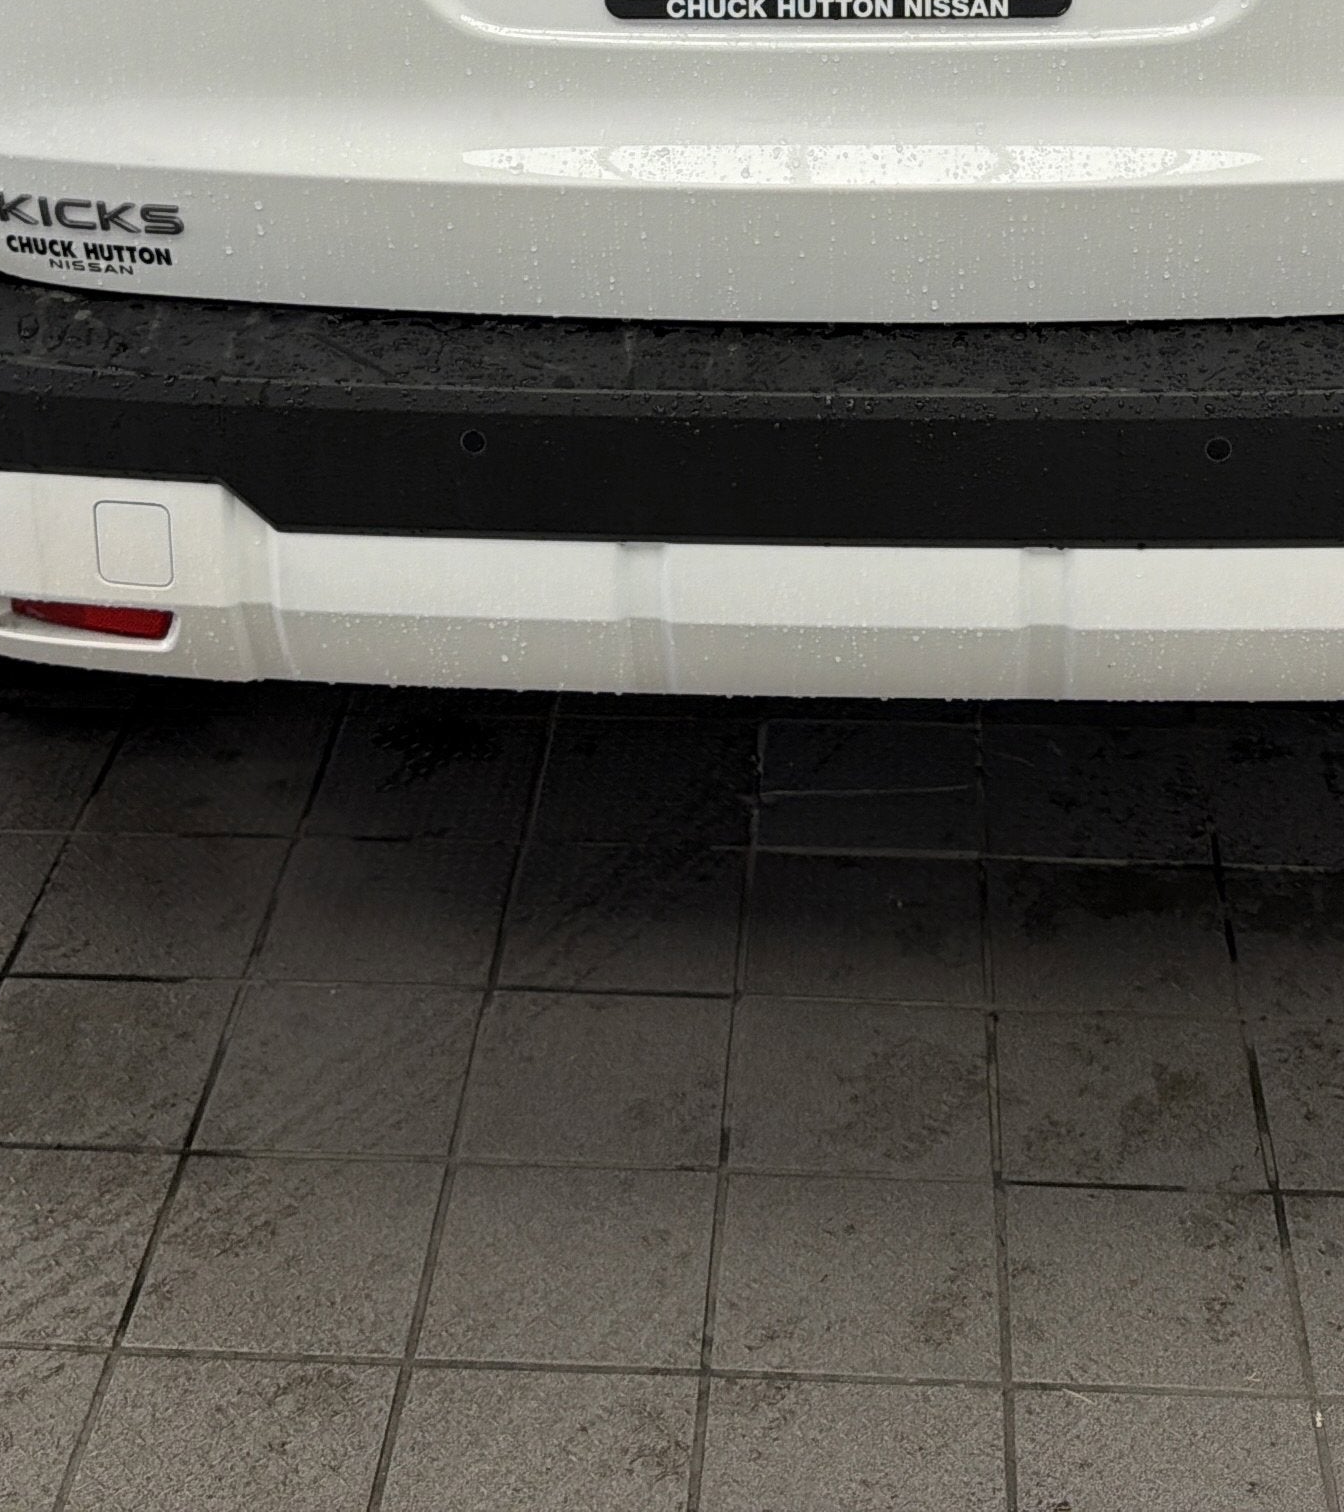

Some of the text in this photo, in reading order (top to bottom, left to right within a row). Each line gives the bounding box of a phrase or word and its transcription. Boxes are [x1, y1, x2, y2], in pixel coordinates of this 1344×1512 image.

[6, 234, 173, 266] CHUCK HUTTON
[49, 258, 134, 275] NISSAN
